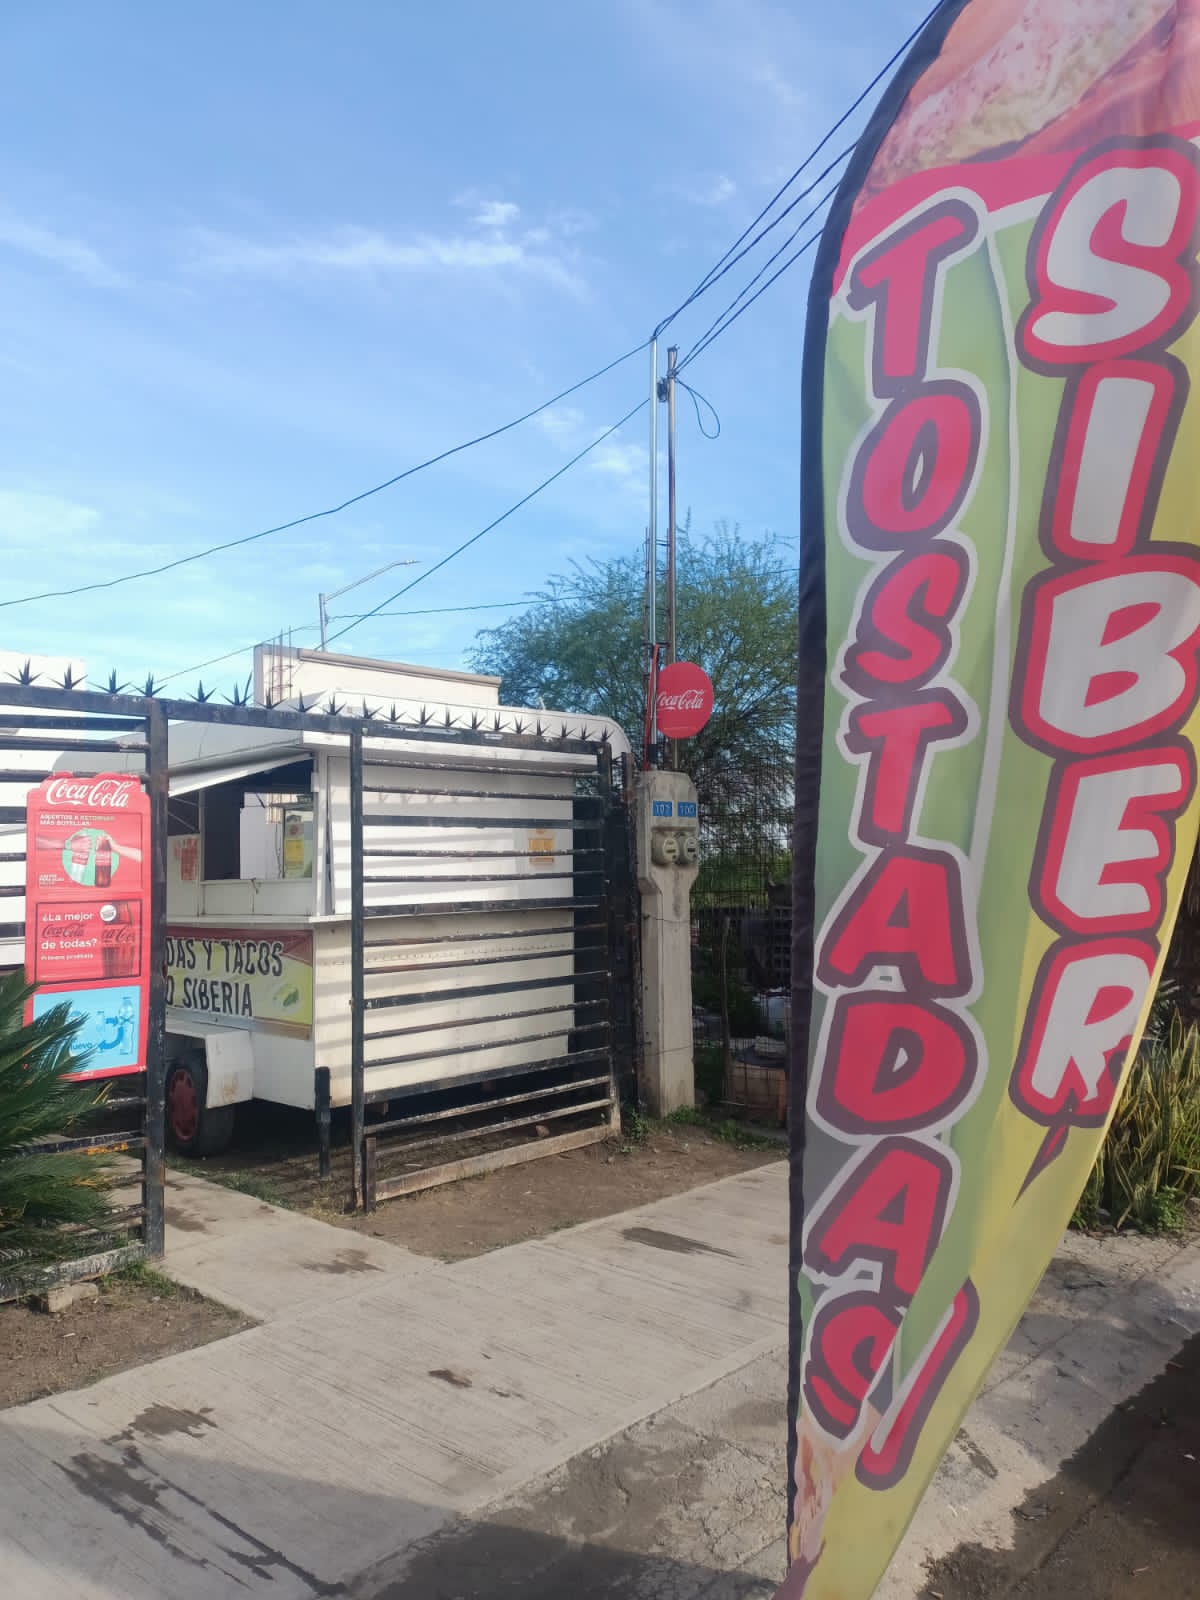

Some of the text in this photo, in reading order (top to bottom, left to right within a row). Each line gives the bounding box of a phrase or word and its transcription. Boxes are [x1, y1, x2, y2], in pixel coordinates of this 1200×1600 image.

[46, 778, 133, 808] Coca-Cola
[802, 198, 983, 1440] TOSTADAS
[43, 913, 61, 922] ¿La
[64, 912, 95, 922] mejor
[41, 938, 98, 950] de todas?
[165, 936, 283, 976] DAS Y TACOS
[183, 977, 253, 1017] SIBERIA
